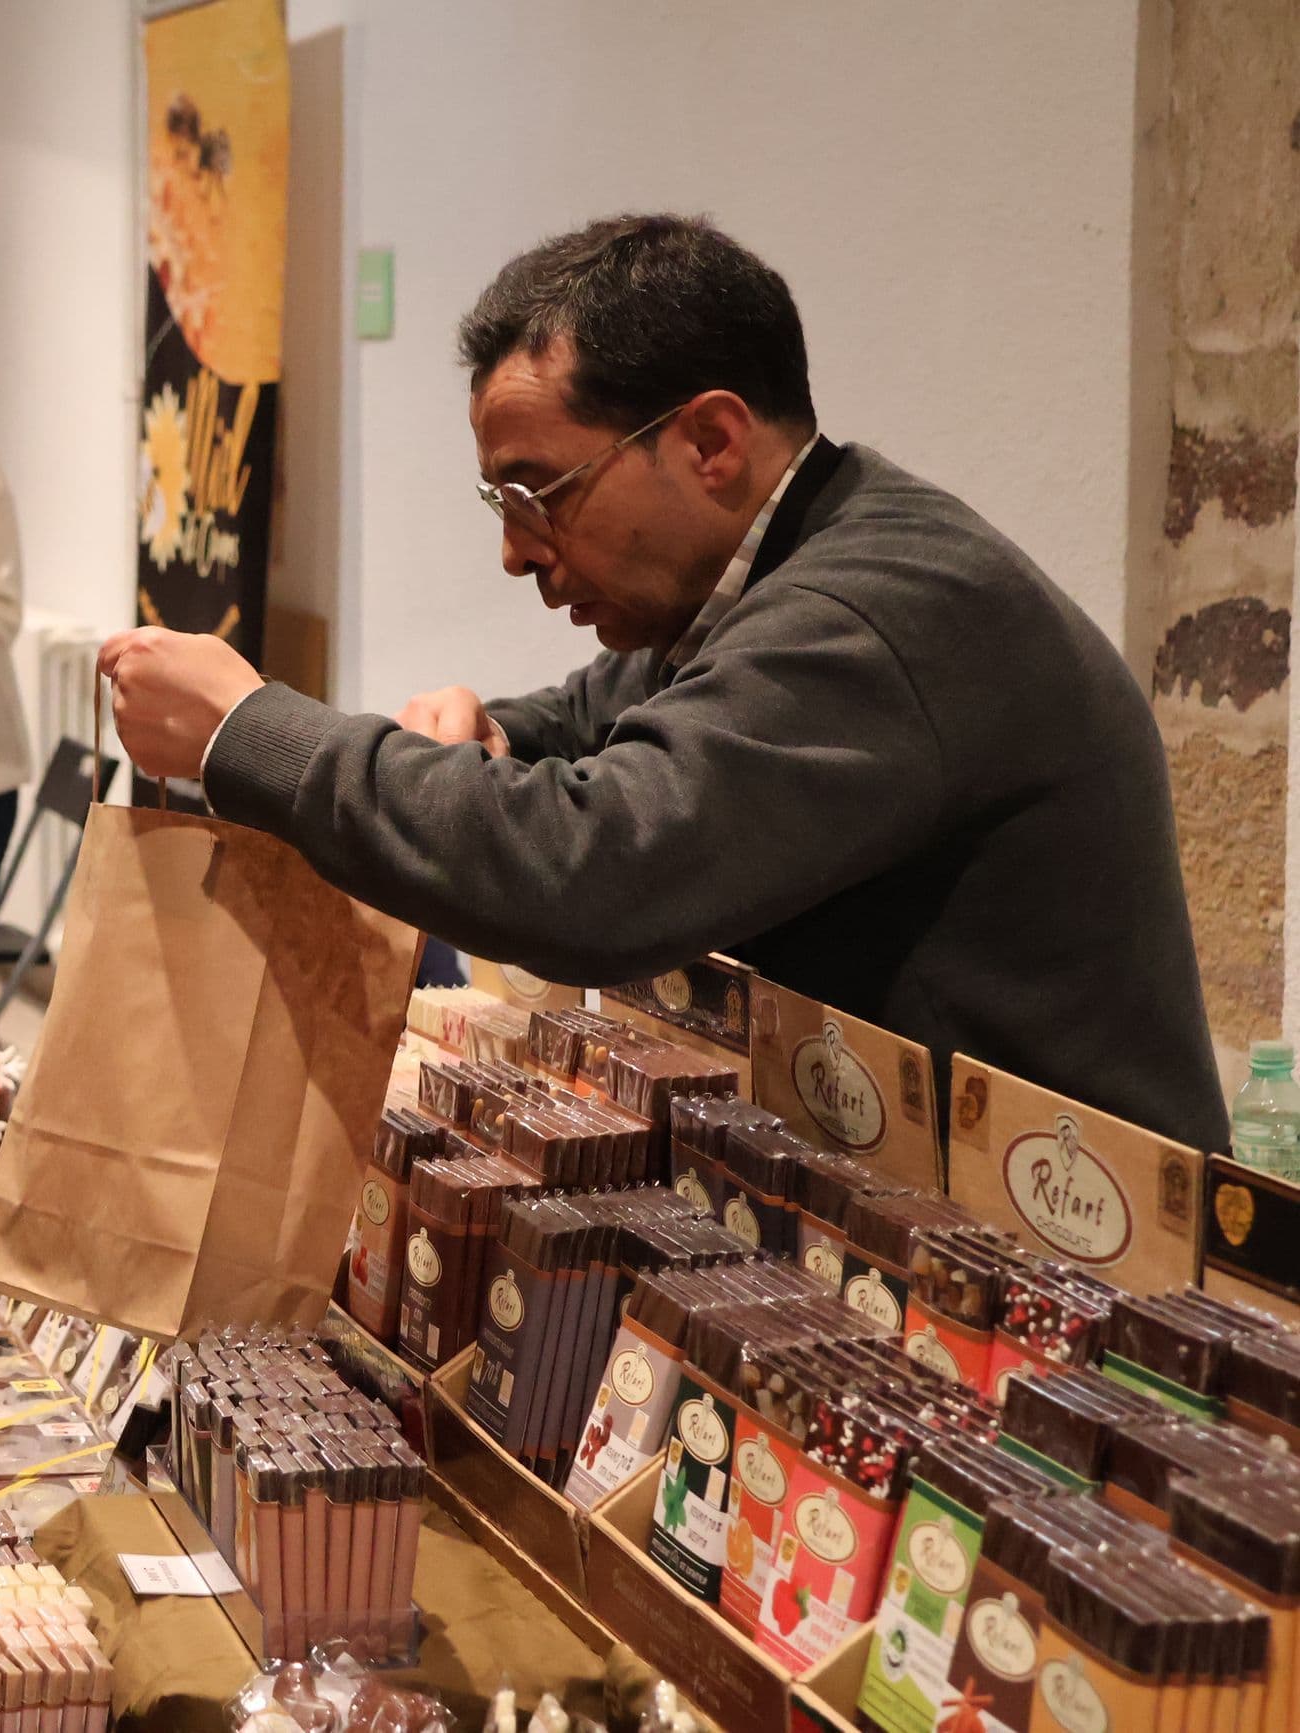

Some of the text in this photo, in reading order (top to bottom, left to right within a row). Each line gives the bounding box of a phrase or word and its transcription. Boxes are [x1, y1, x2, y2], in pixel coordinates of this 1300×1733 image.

[811, 1062, 865, 1117] Refart
[1031, 1158, 1105, 1226] Refart
[1035, 1215, 1093, 1253] CHOCOLATE
